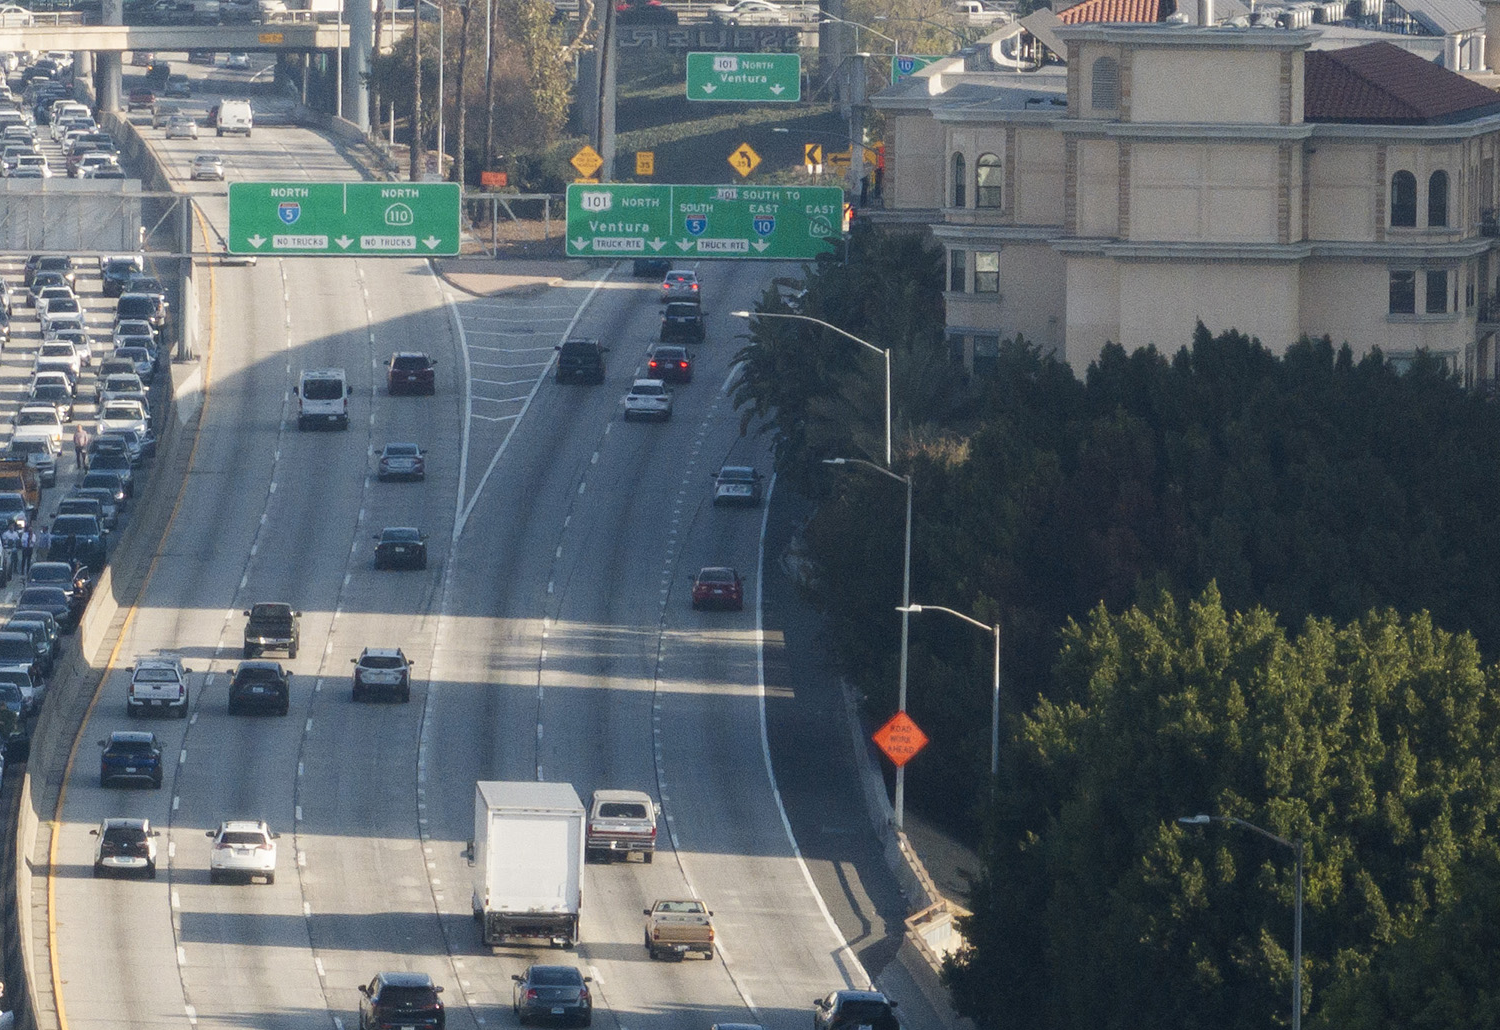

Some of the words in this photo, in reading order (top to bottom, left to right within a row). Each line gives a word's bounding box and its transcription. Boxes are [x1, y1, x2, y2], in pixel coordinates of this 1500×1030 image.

[719, 60, 733, 68] 101
[901, 60, 911, 70] 10
[720, 73, 768, 83] Ventura
[270, 188, 309, 198] NORTH
[381, 188, 420, 198] NORTH
[719, 190, 736, 199] 101
[743, 190, 780, 201] SOUTH
[785, 191, 800, 201] TO
[586, 196, 607, 208] 101
[621, 198, 660, 208] NORTH
[680, 203, 714, 213] SOUTH
[749, 204, 779, 214] EAST
[805, 205, 835, 214] EAST
[285, 209, 294, 220] 5
[389, 210, 408, 222] 110
[589, 220, 650, 233] Ventura
[692, 220, 700, 231] 5
[757, 221, 771, 232] 10
[276, 238, 288, 246] NO
[291, 238, 324, 247] TRUCKS
[364, 239, 376, 247] NO
[380, 239, 412, 247] TRUCKS
[596, 239, 623, 248] TRUCK
[626, 240, 641, 249] RTE
[700, 240, 729, 249] TRUCK
[731, 241, 745, 250] RTE
[890, 725, 913, 733] ROAD
[888, 745, 915, 754] AHEAD
